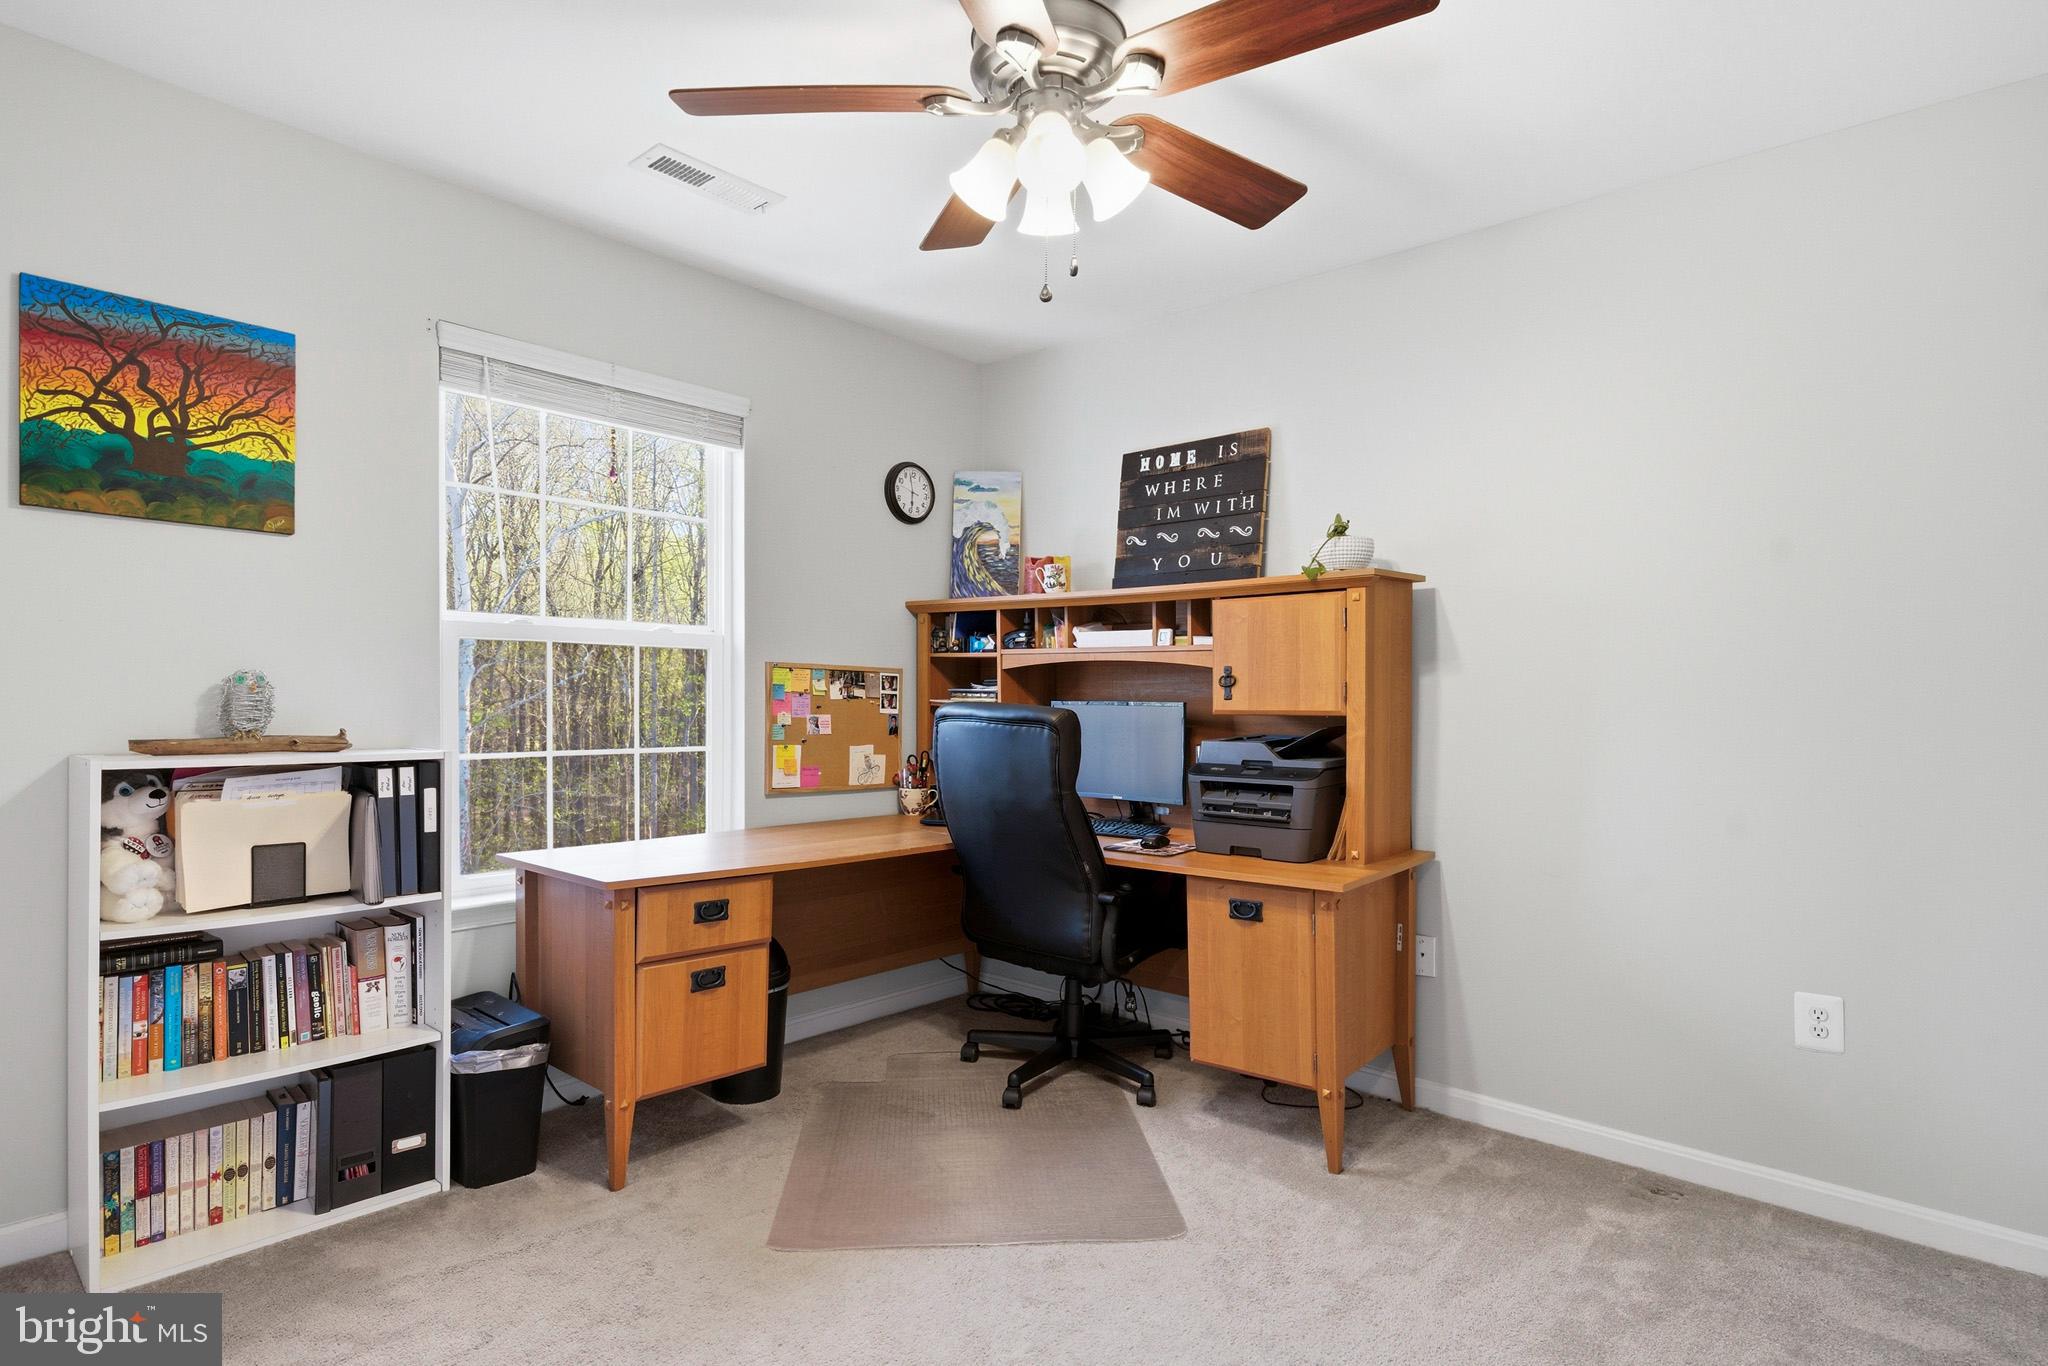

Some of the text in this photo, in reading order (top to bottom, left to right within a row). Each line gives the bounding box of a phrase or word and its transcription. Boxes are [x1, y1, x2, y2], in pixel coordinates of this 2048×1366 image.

[1140, 442, 1239, 472] HOME IS
[1145, 474, 1223, 497] WHERE
[1156, 495, 1255, 521] IM WITH
[1152, 552, 1223, 571] YOU
